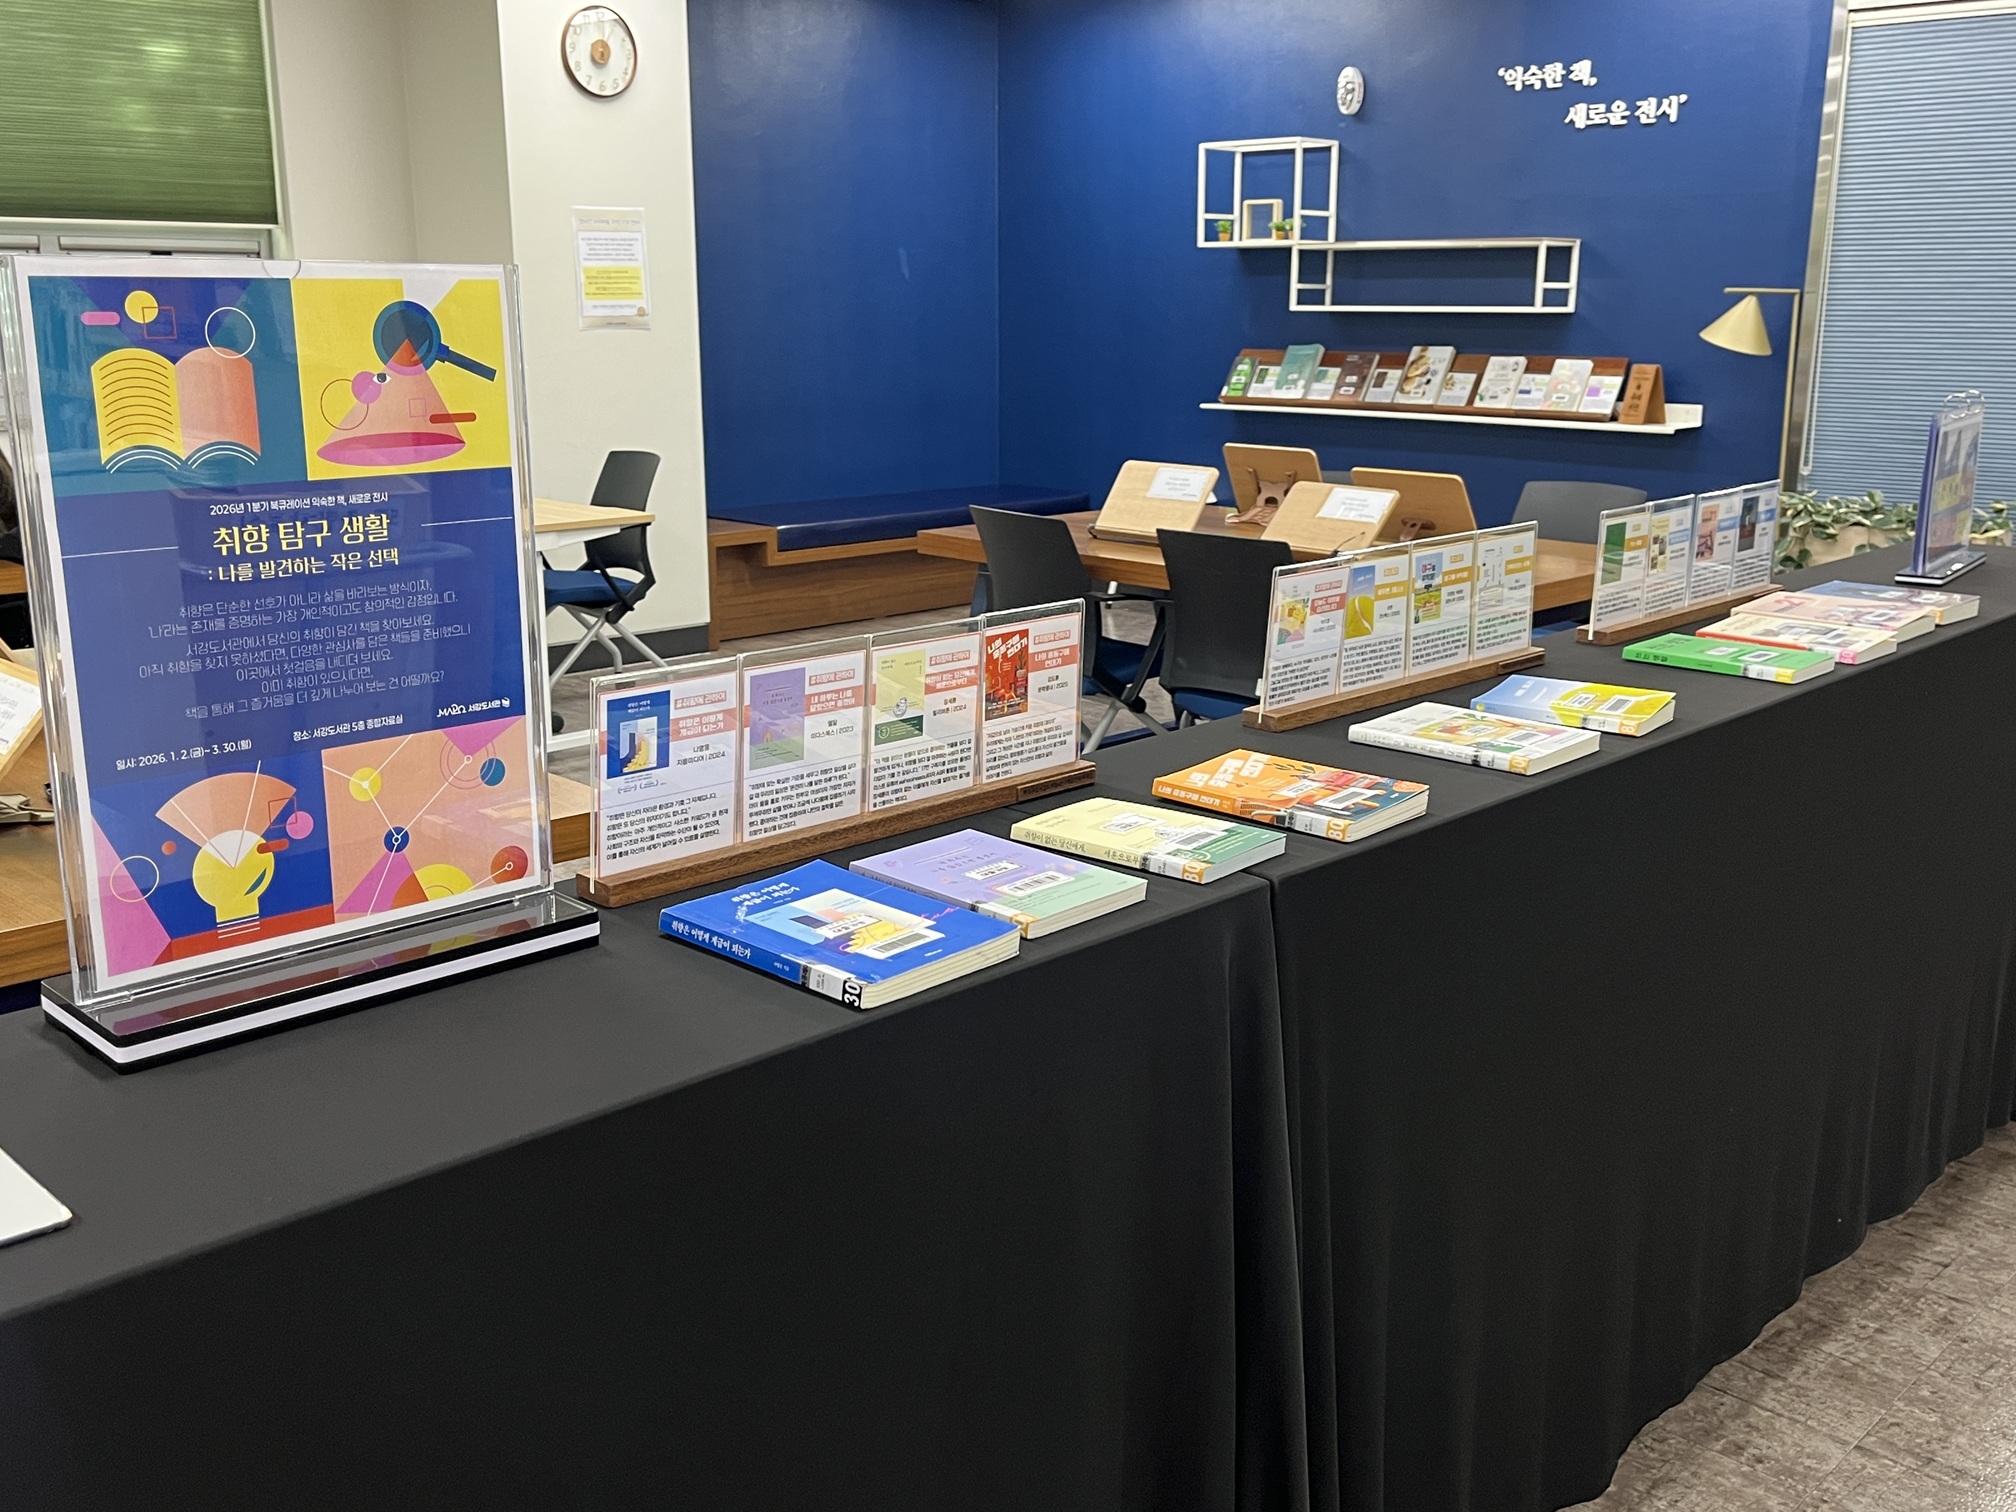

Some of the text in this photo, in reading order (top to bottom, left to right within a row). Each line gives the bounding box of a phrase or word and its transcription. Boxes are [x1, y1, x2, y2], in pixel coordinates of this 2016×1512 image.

[599, 81, 606, 91] 6
[1568, 60, 1598, 86] 책,
[1564, 100, 1631, 129] 새로운
[210, 492, 388, 515] 2026년 1분기 북큐레이션 익숙한 책, 새로운 전시
[213, 513, 390, 555] 취향 탐구 생활
[218, 563, 254, 583] 나를
[259, 556, 326, 579] 발견하는
[330, 552, 362, 570] 작은
[368, 548, 399, 568] 선택
[180, 580, 432, 618] 취향은 단순한 선호가 아니라 삶을 바라보는 방식이자,
[191, 618, 225, 633] 존재를
[229, 614, 273, 629] 증명하는
[276, 611, 297, 623] 가장
[301, 602, 363, 620] 개인적이고도
[364, 597, 404, 612] 창의적인
[407, 591, 458, 607] 감정입니다.
[186, 614, 434, 656] 서강도서관에서 당신의 취향이 담긴 책을 찾아보세요.
[139, 623, 470, 678] 아직 취향을 찾지 못하셨다면, 다양한 관심사를 담은 책들을 준비했으니
[236, 648, 393, 681] 이곳에서 첫걸음을 내디뎌 보세요.
[261, 666, 373, 693] 이미 취향이 있으시다면,
[185, 671, 445, 719] 책을 통해 그 즐거움을 더 깊게 나누어 보는 건 어떨까요?
[468, 699, 501, 713] 서강도서관
[293, 714, 403, 742] 장소: 서강도서관 5층 종합자료실
[679, 717, 700, 728] 취향은
[839, 726, 854, 734] 2023
[115, 759, 137, 770] 일시:
[138, 753, 167, 767] 2026.
[171, 752, 179, 761] 1.
[212, 744, 221, 755] 3.
[222, 739, 252, 754] 30.(월)
[708, 751, 726, 760] 2024
[1158, 785, 1172, 794] 나의
[1024, 830, 1044, 843] 취향이
[1045, 835, 1057, 846] 없는
[1059, 839, 1086, 853] 당신에게,
[1327, 819, 1345, 840] 80
[1183, 861, 1203, 881] 80
[671, 920, 751, 960] 취향은 어떻게 계급이 되는가
[844, 980, 861, 1007] 30
